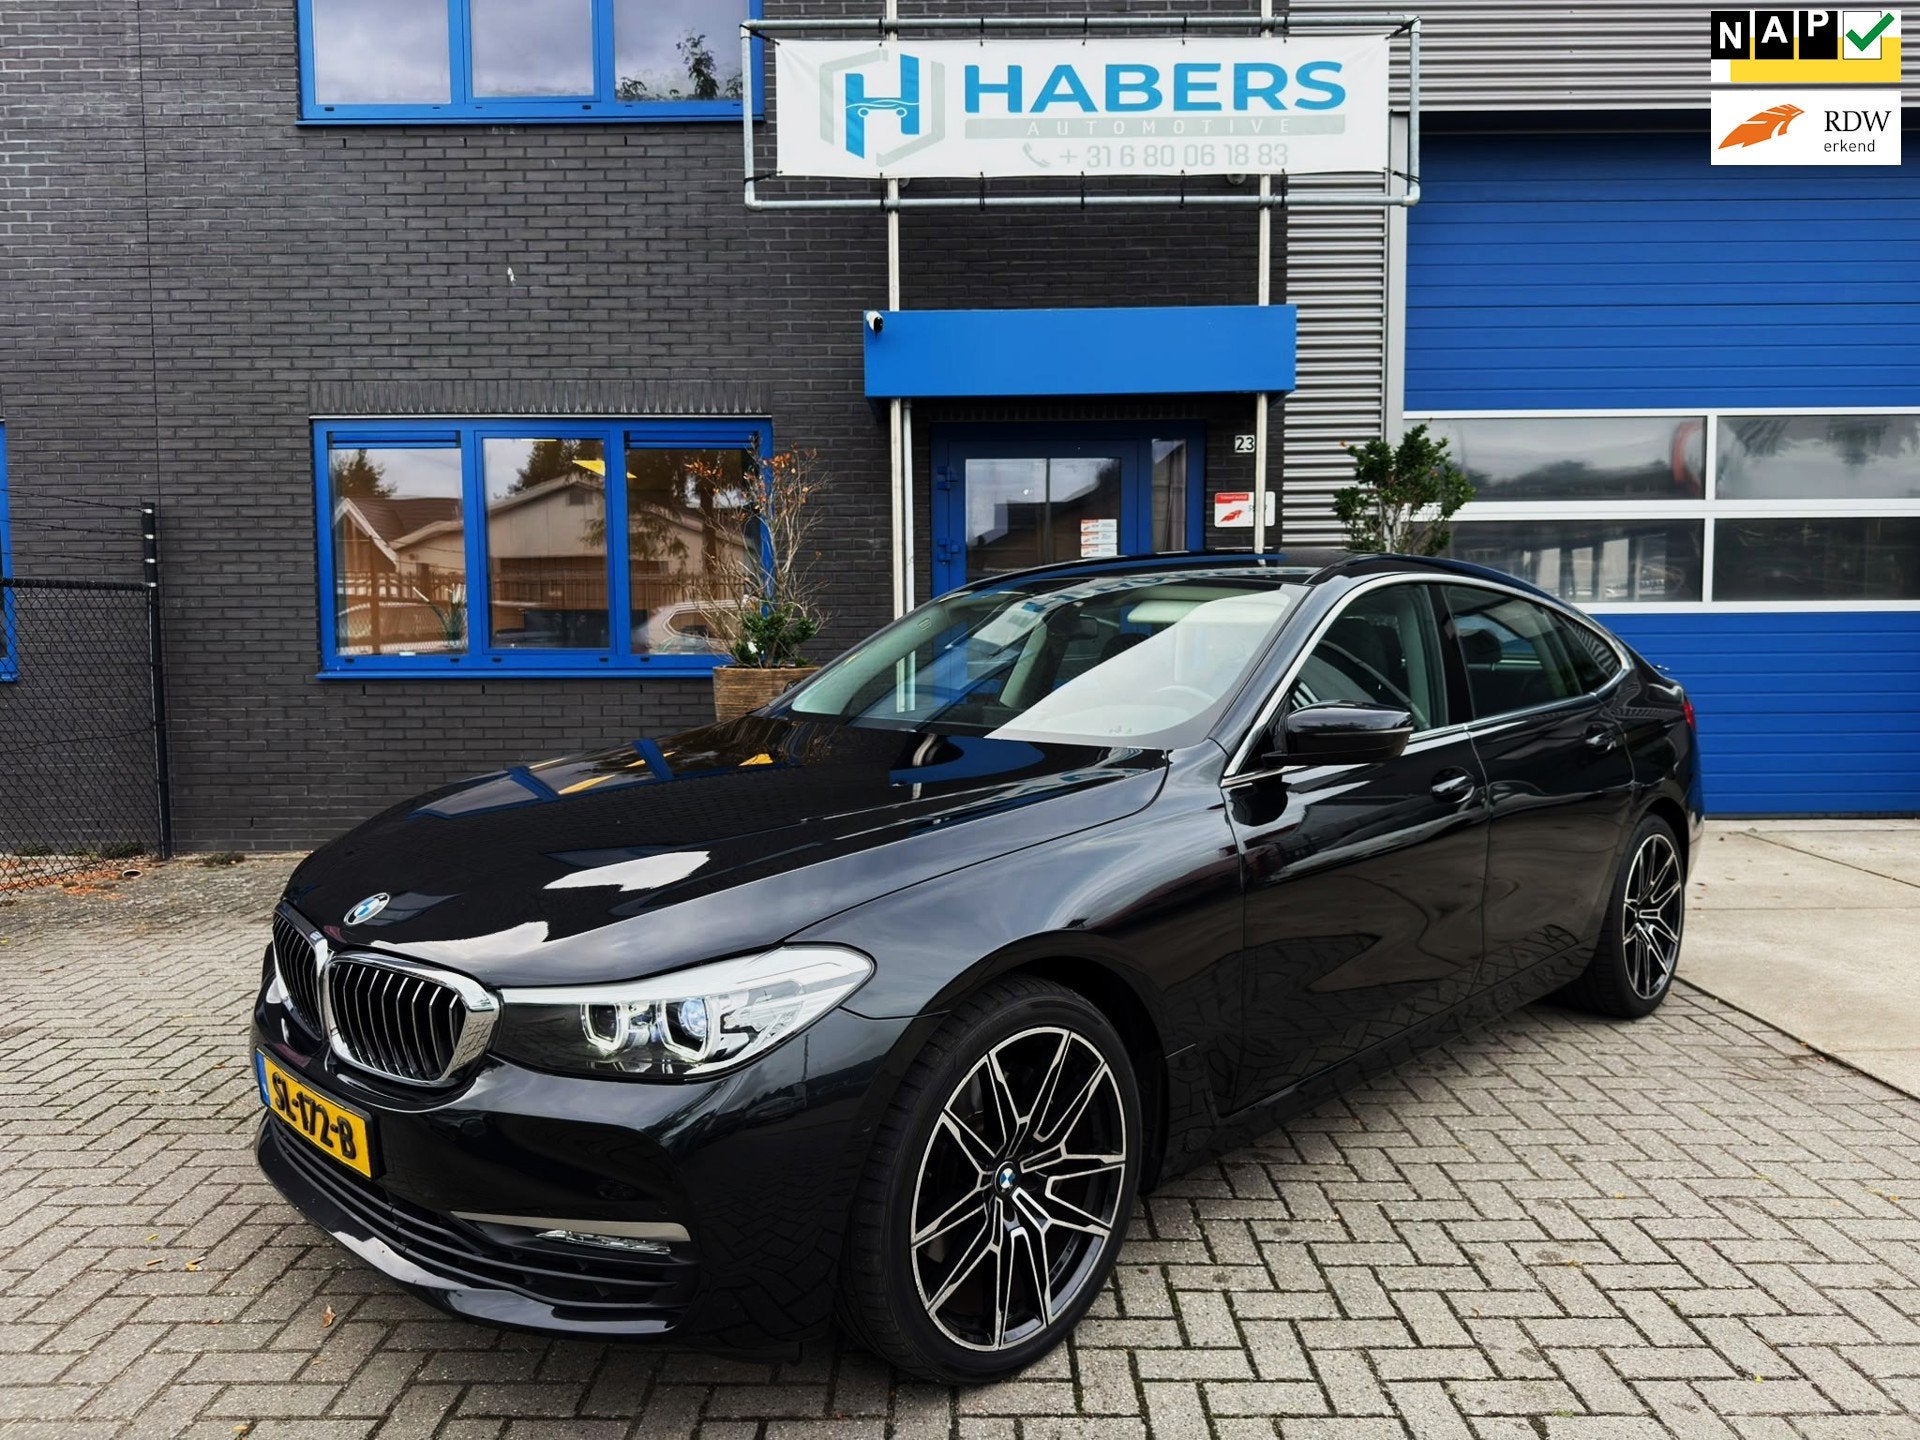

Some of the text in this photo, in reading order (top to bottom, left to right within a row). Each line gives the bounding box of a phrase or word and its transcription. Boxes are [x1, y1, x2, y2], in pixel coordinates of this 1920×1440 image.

[964, 61, 1347, 114] HABERS
[1027, 119, 1291, 137] AUTOMOTIVE
[1235, 436, 1255, 451] 23
[272, 1071, 357, 1160] SL-172-B
